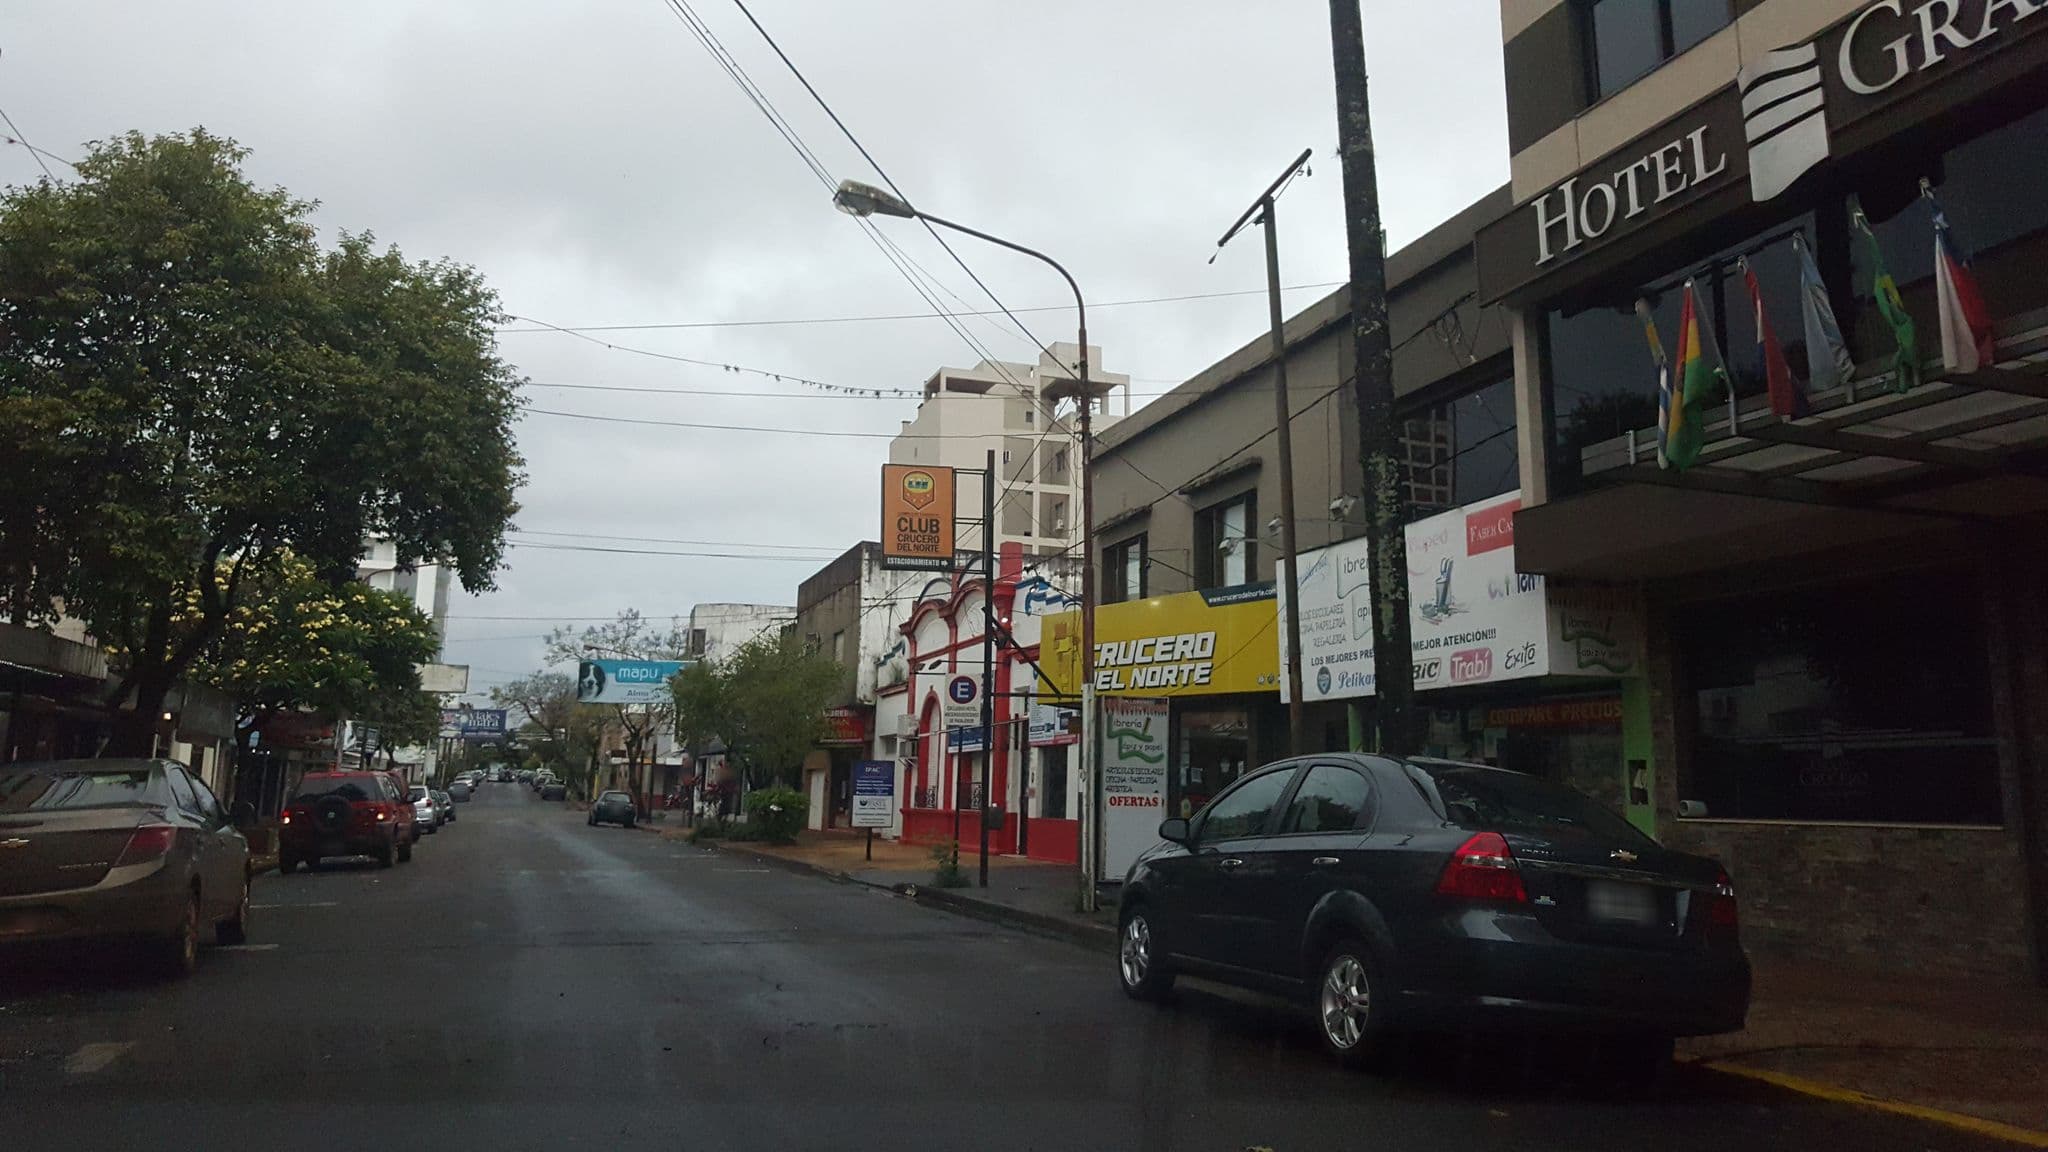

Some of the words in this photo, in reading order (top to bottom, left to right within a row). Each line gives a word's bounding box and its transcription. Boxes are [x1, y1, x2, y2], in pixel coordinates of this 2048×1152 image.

[1531, 125, 1725, 266] HOTEL
[1839, 0, 2048, 94] GRA
[897, 517, 940, 533] CLUB
[897, 533, 940, 544] CRUCERO
[897, 543, 912, 552] DEL
[914, 544, 939, 552] NORTE
[1412, 637, 1441, 651] MEJOR
[1311, 656, 1324, 666] LOS
[1325, 652, 1358, 664] MEJORES
[1359, 648, 1376, 659] PRE
[618, 667, 659, 681] mapu
[1094, 669, 1125, 690] EL
[1130, 662, 1213, 688] NORTE
[957, 682, 969, 698] E
[1109, 795, 1159, 807] OFERTAS
